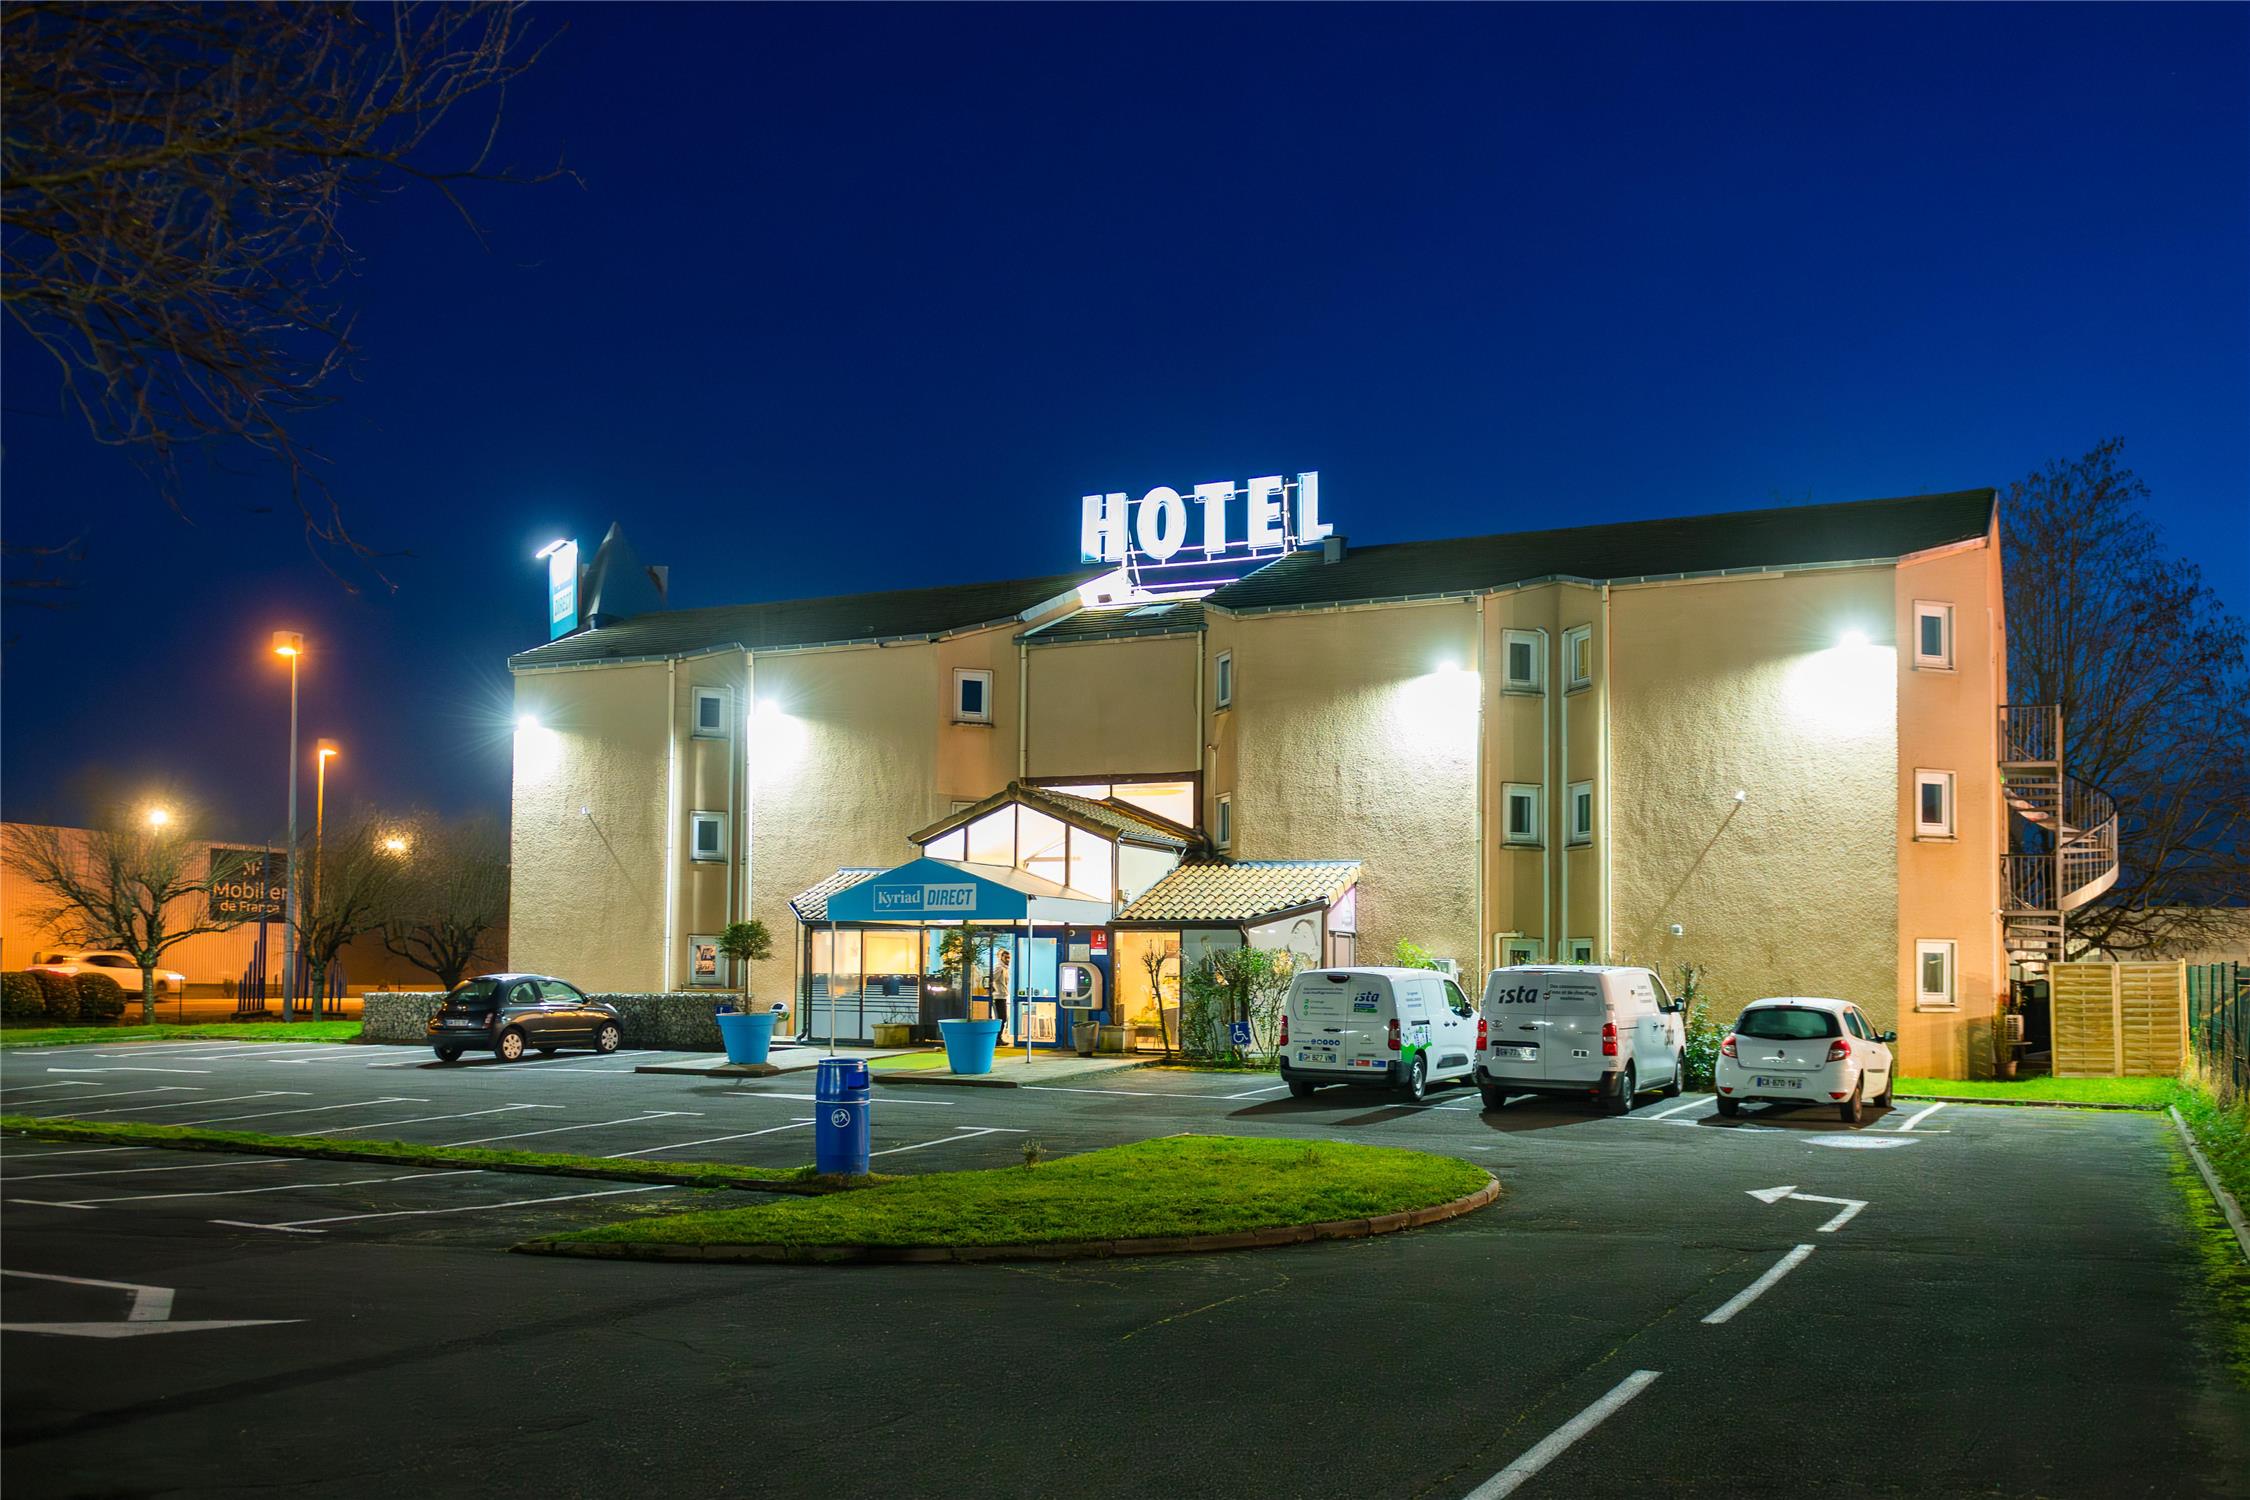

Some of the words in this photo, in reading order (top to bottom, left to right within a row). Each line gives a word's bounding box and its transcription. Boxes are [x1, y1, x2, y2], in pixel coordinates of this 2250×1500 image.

[1081, 471, 1333, 564] HOTEL
[213, 881, 288, 900] Mobiler
[878, 889, 920, 908] Kyriad
[927, 889, 973, 906] DIRECT
[220, 900, 236, 912] de
[1097, 934, 1106, 942] H
[1354, 990, 1380, 1003] ista
[1498, 985, 1538, 1004] ista
